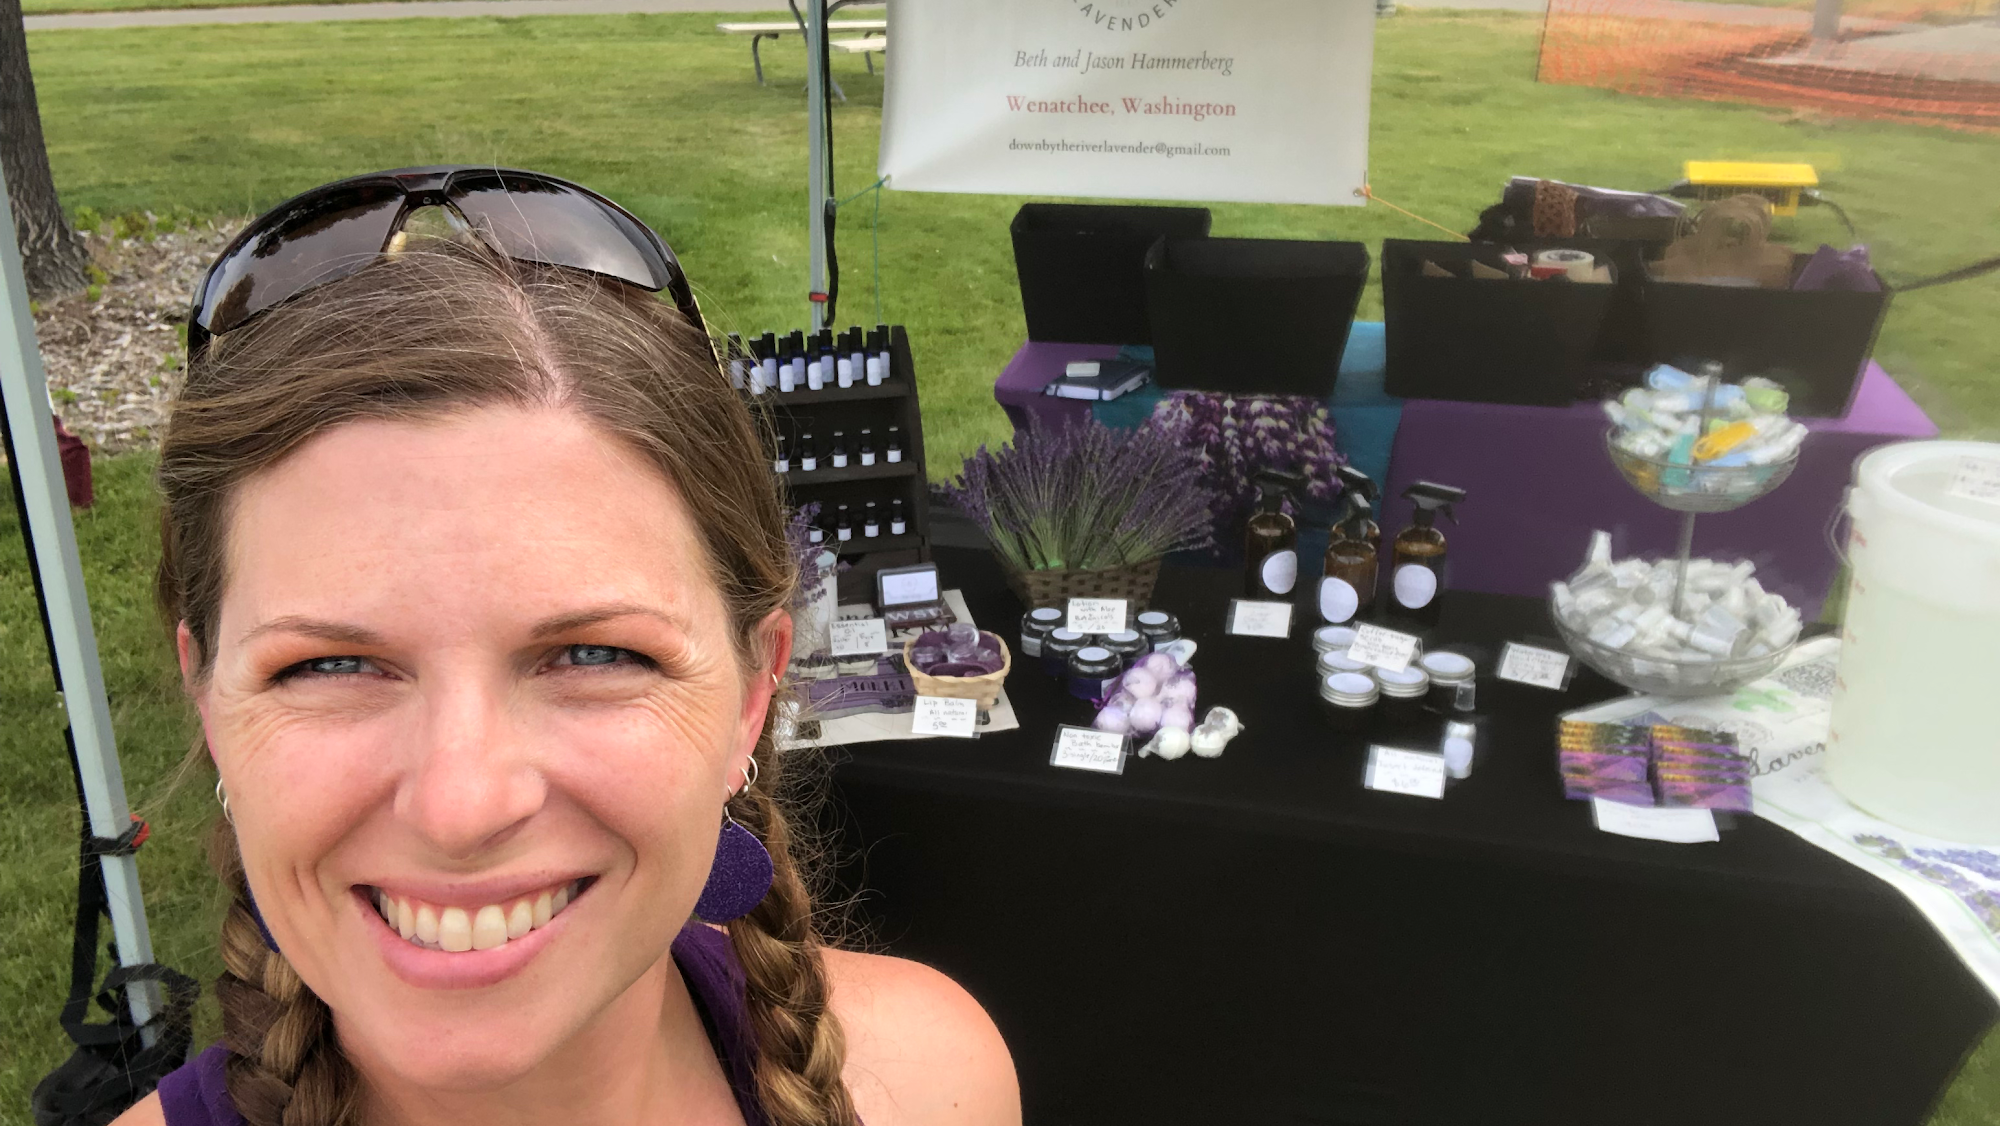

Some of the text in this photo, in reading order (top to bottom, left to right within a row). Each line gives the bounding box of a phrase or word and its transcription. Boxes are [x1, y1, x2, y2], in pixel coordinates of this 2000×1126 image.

[1071, 0, 1178, 31] AVENDER
[1014, 48, 1234, 76] Beth and Jason Hammerberg
[1006, 95, 1236, 122] Wenatchee, Washington
[1008, 138, 1231, 158] downbytheriverlavender@gmail.com
[923, 697, 965, 708] Lip Balm
[1071, 739, 1091, 748] Bath
